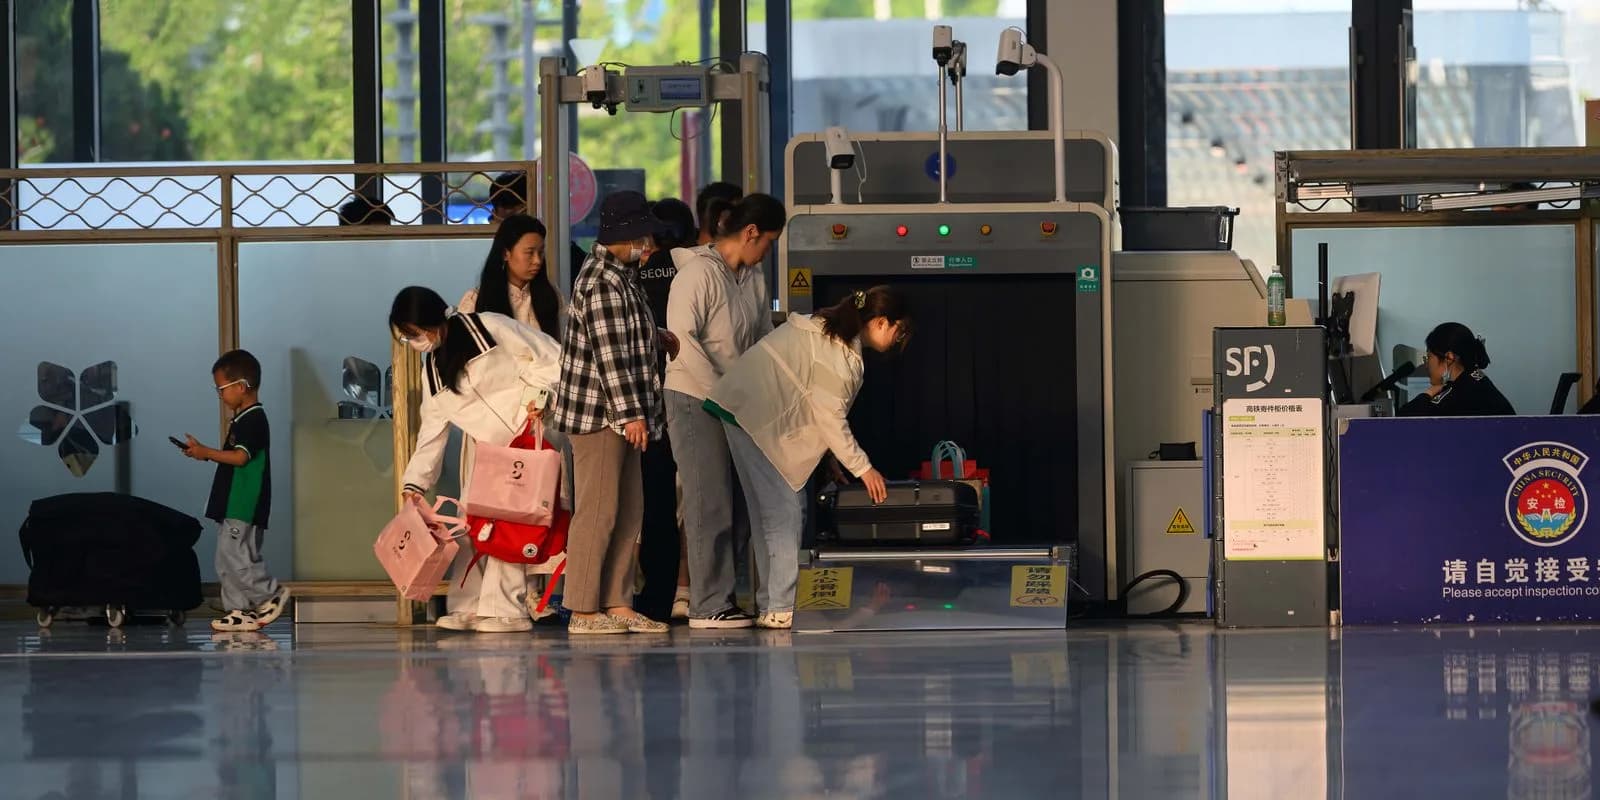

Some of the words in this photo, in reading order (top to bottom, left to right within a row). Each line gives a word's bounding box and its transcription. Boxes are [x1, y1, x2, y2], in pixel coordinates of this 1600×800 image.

[1513, 447, 1581, 466] 中华人民共和国
[1513, 472, 1537, 497] CHINA
[1538, 470, 1580, 497] SECURITY
[1442, 556, 1600, 585] 请自觉接受
[1442, 587, 1482, 598] Please
[1484, 587, 1523, 599] accept
[1525, 586, 1583, 599] inspection
